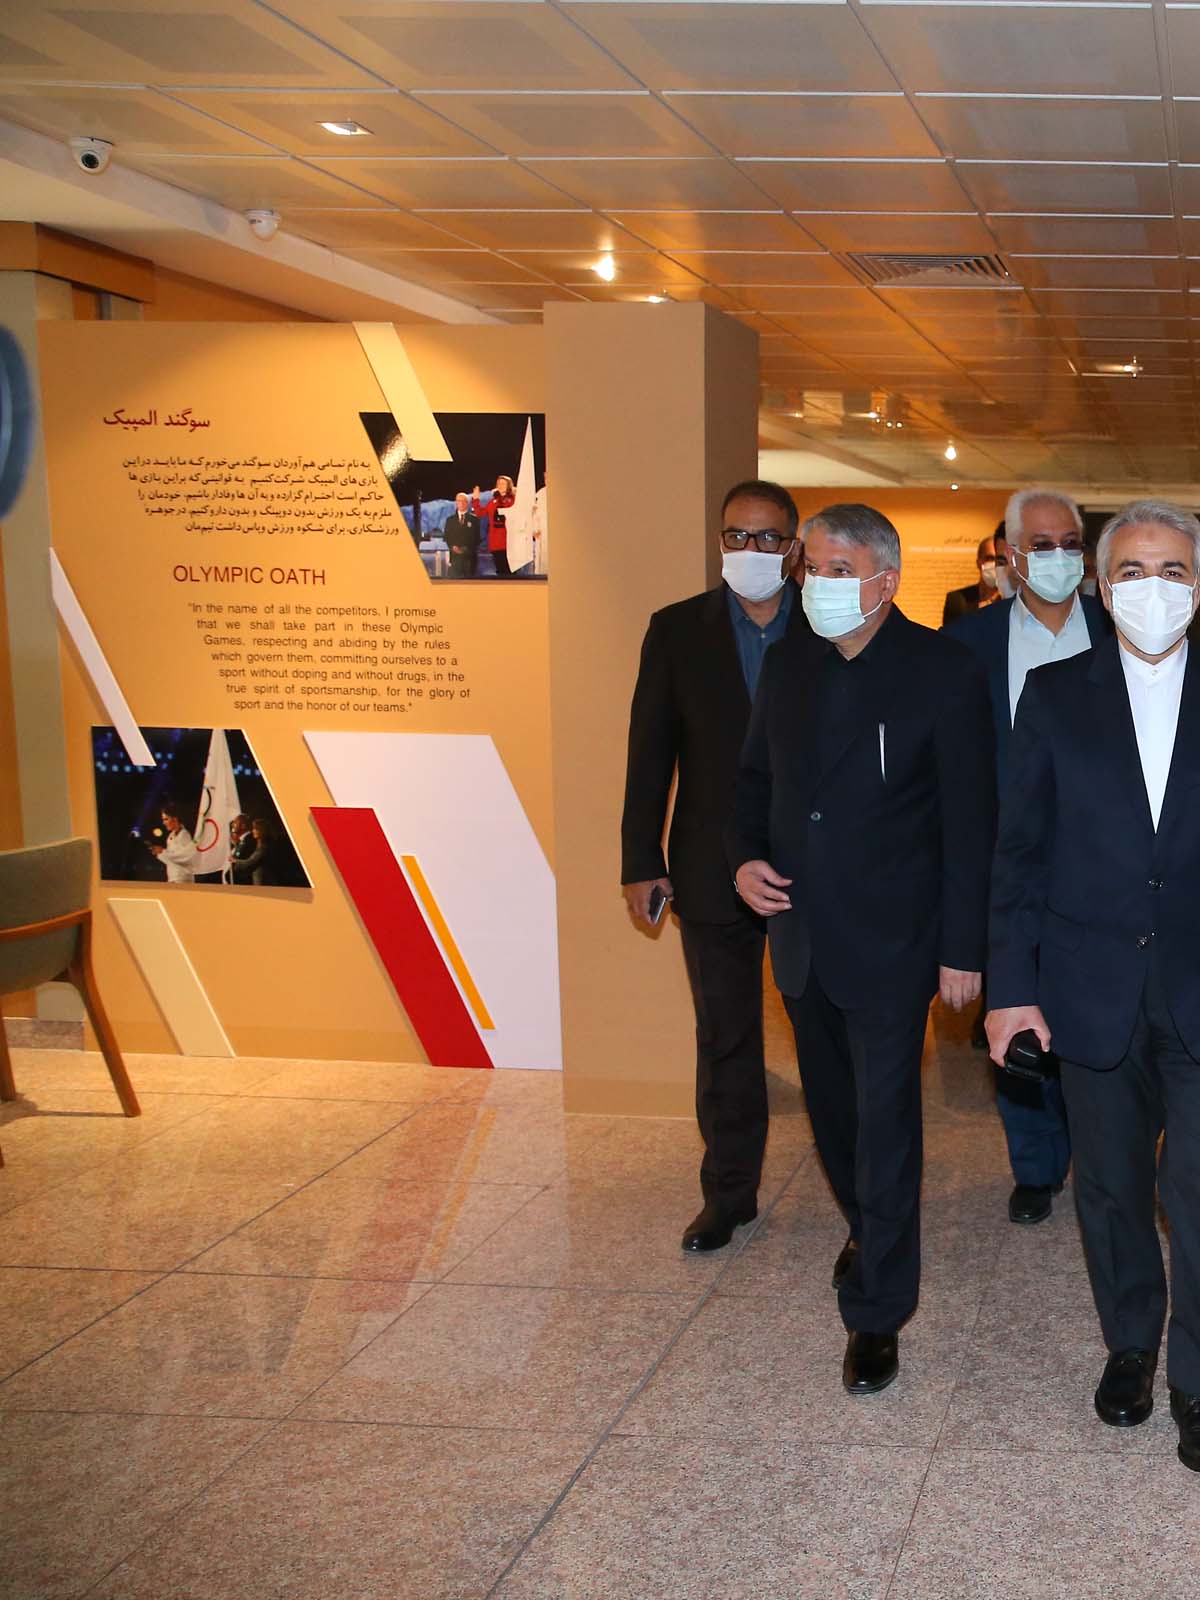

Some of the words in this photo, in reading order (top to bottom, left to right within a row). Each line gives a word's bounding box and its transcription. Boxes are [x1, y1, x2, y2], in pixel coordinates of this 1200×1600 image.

[103, 409, 157, 431] المپیک
[164, 408, 210, 433] سوگند
[242, 457, 271, 469] سوگند
[318, 459, 345, 470] تمامی
[308, 475, 338, 486] المپیک
[358, 475, 378, 487] بازی
[304, 491, 335, 502] احترام
[337, 491, 357, 500] است
[359, 491, 384, 503] حاکم
[260, 505, 292, 518] دوپینگ
[317, 508, 344, 518] ورزش
[267, 524, 294, 534] ورزش
[173, 565, 264, 584] OLYMPIC
[269, 568, 326, 585] OATH
[206, 603, 223, 615] the
[228, 606, 257, 614] name
[264, 604, 274, 614] of
[279, 604, 290, 614] all
[295, 604, 312, 615] the
[394, 609, 436, 619] promise
[197, 620, 216, 629] that
[225, 621, 240, 630] we
[250, 620, 275, 630] shall
[283, 621, 306, 630] take
[315, 622, 335, 632] part
[344, 623, 353, 632] in
[362, 622, 391, 632] these
[400, 622, 443, 635] Olympic
[252, 636, 307, 649] respecting
[313, 638, 333, 647] and
[339, 638, 377, 650] abiding
[383, 639, 395, 651] by
[402, 639, 418, 648] the
[424, 640, 450, 649] rules
[211, 651, 242, 663] which
[247, 654, 283, 664] govern
[320, 654, 378, 667] committing
[381, 655, 432, 665] ourselves
[436, 656, 446, 665] to
[451, 658, 458, 666] a
[219, 665, 246, 678] sport
[250, 668, 288, 678] without
[292, 669, 328, 681] doping
[331, 670, 351, 679] and
[355, 671, 393, 680] without
[434, 672, 443, 680] in
[448, 672, 464, 682] the
[226, 684, 247, 693] true
[254, 684, 279, 695] spirit
[285, 684, 295, 694] of
[387, 686, 400, 696] for
[407, 687, 423, 696] the
[429, 687, 455, 700] glory
[460, 689, 470, 698] of
[234, 700, 260, 710] sport
[264, 701, 284, 710] and
[287, 700, 303, 710] the
[307, 699, 337, 711] honor
[340, 701, 350, 711] of
